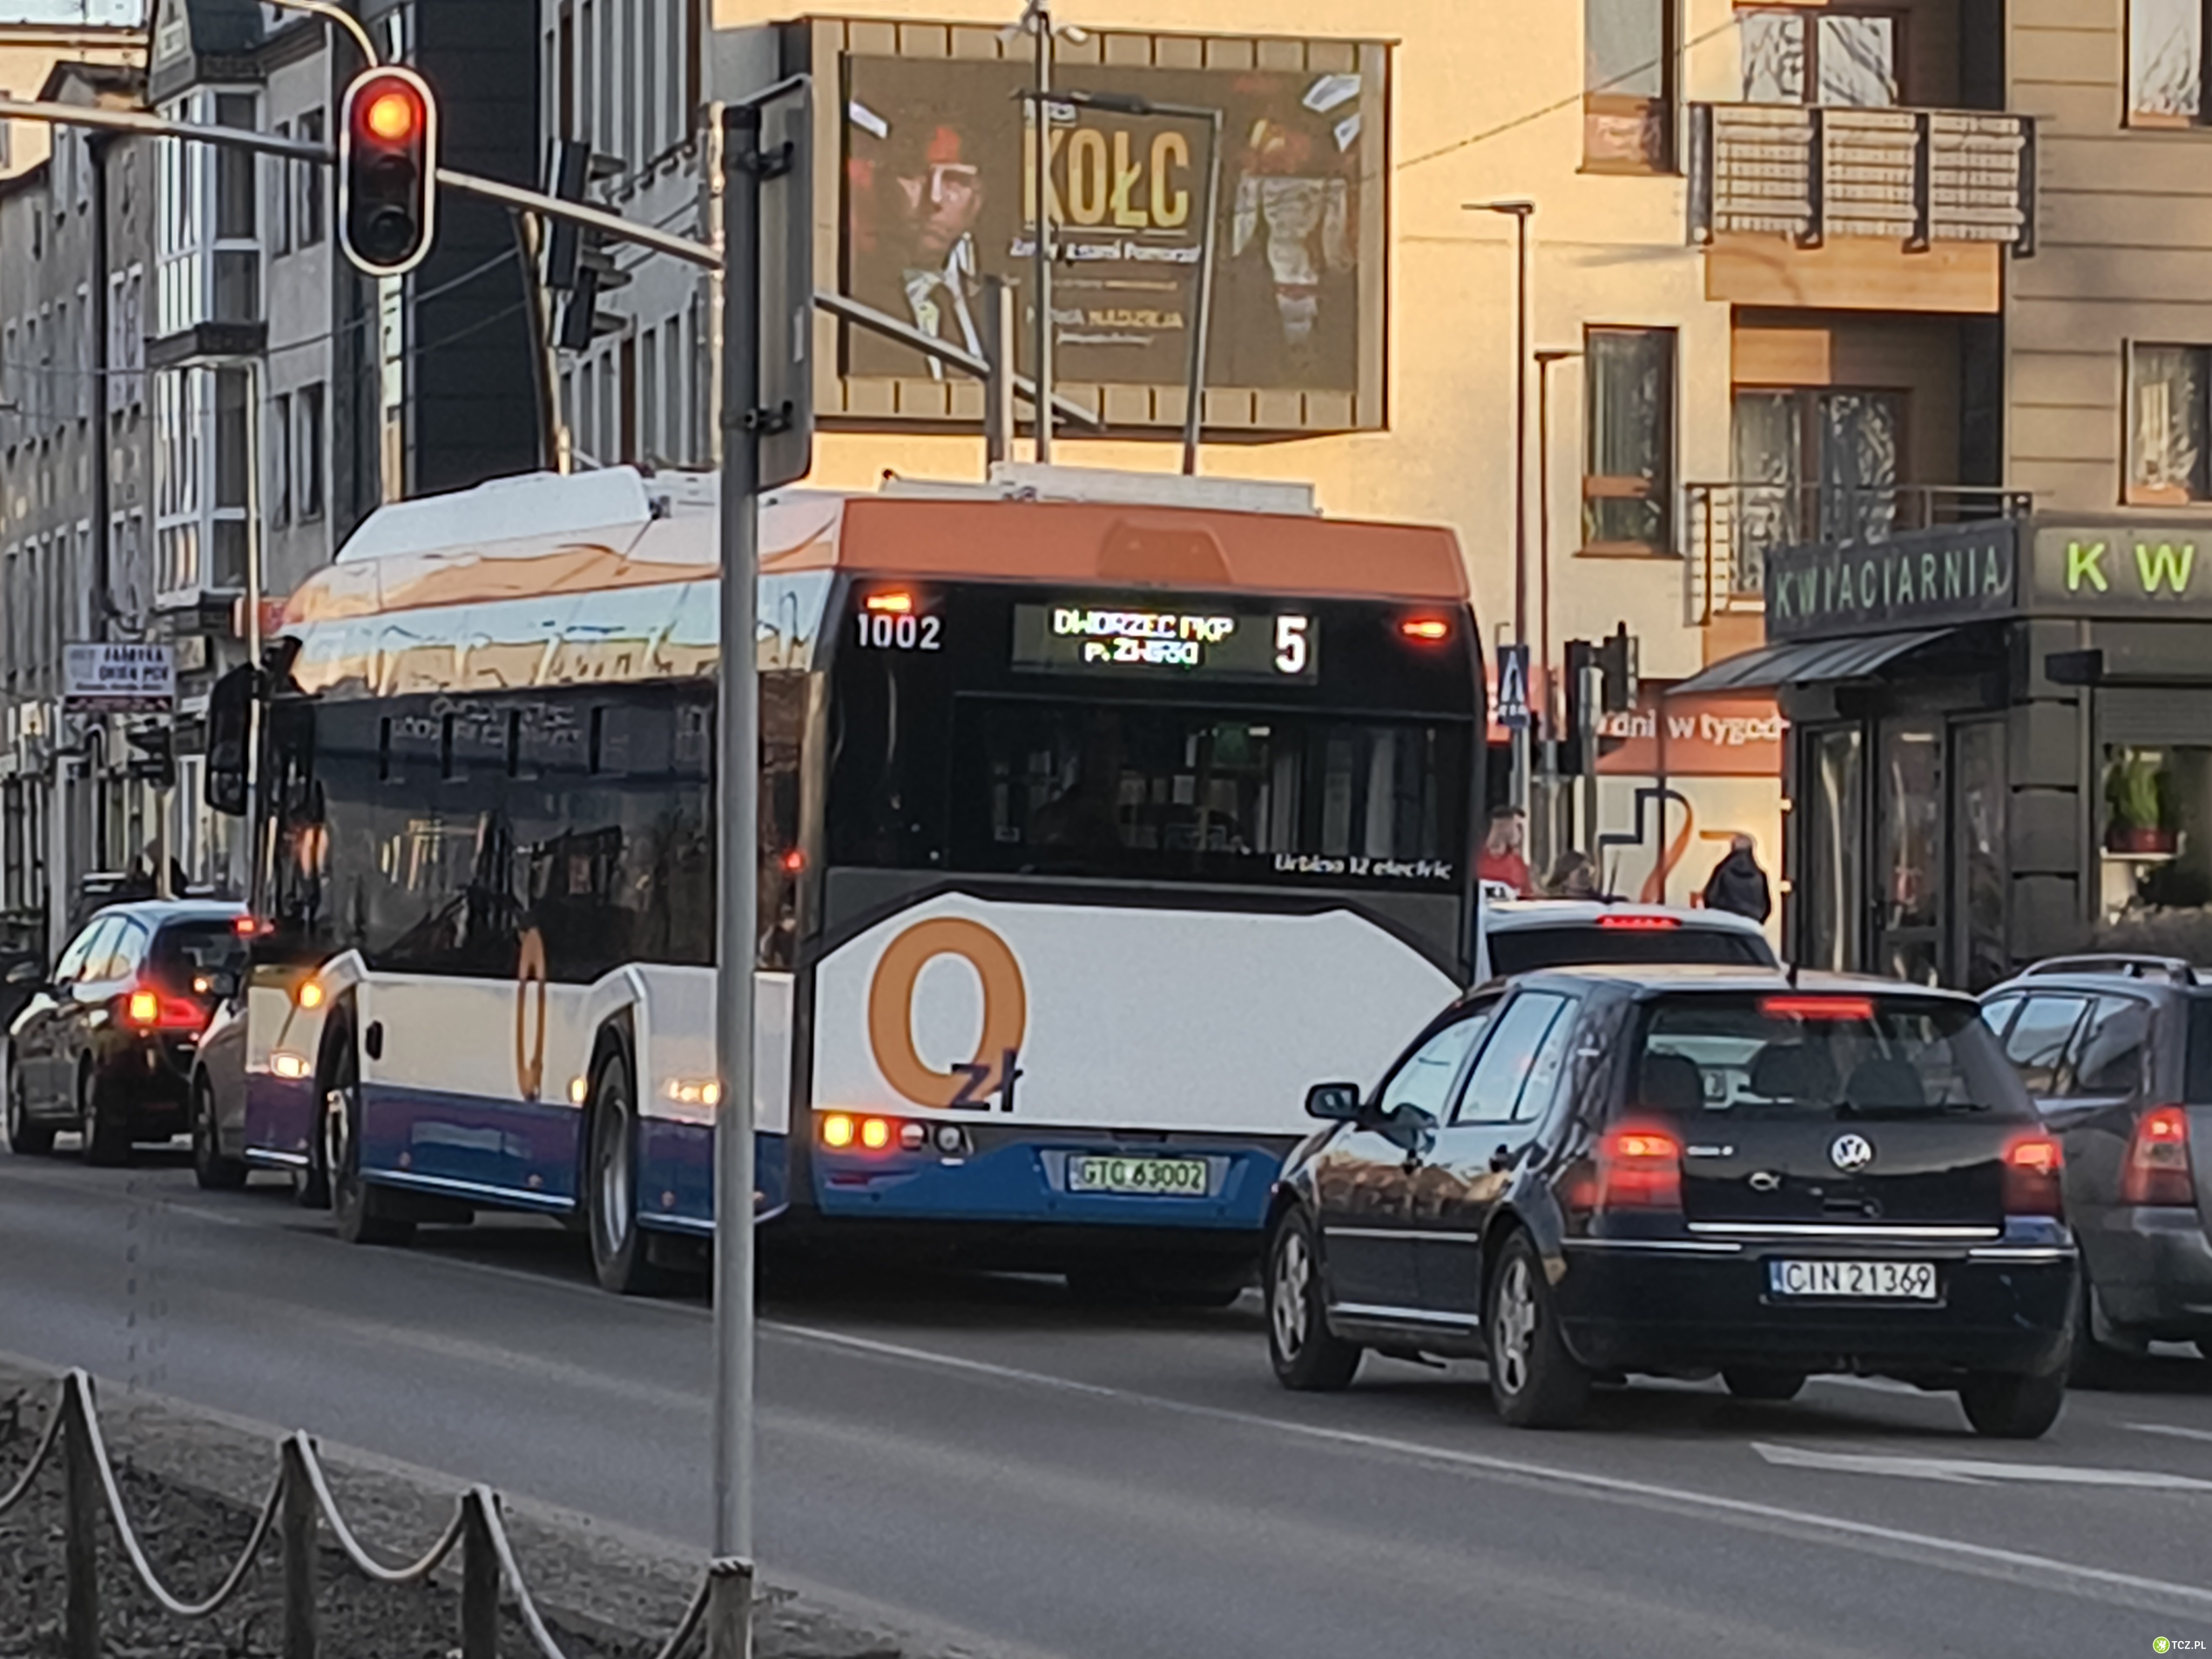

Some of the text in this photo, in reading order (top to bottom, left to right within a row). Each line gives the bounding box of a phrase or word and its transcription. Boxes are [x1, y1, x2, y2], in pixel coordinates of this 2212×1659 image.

[1776, 544, 2000, 619] KWIACIARNIA
[858, 612, 941, 650] 1002
[1275, 616, 1307, 673] 5
[1668, 717, 1696, 739] w
[1701, 710, 1782, 746] tygod
[949, 1048, 1024, 1114] zł
[1786, 1263, 1931, 1294] CIN 21369
